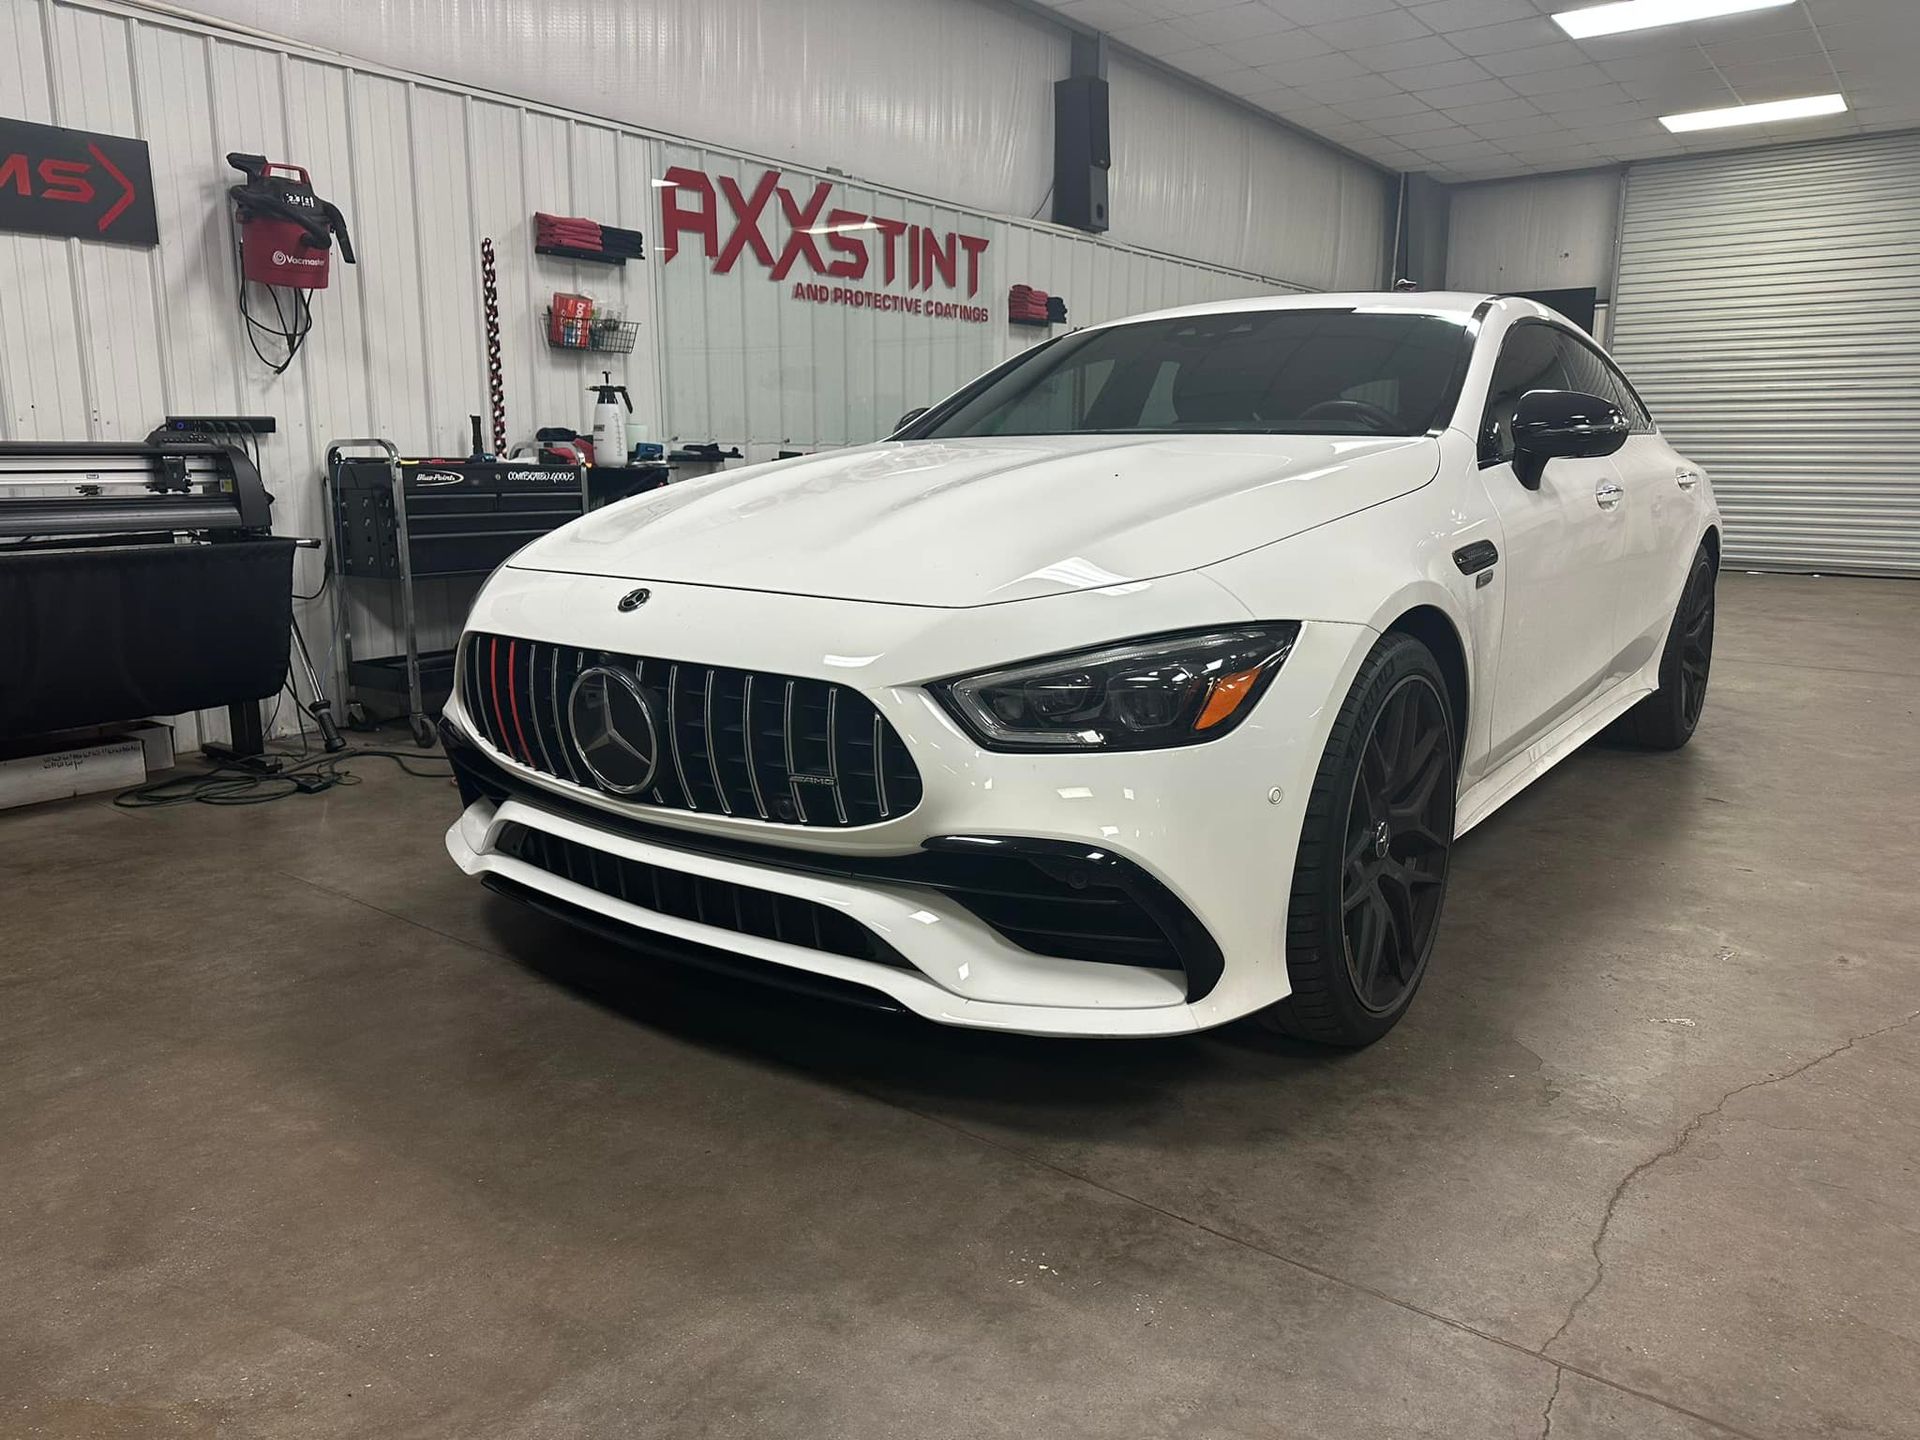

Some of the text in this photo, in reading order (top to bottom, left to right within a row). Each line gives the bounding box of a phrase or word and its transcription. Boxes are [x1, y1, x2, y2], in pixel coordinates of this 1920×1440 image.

[794, 282, 989, 322] AND PROTECTIVE COATINGS
